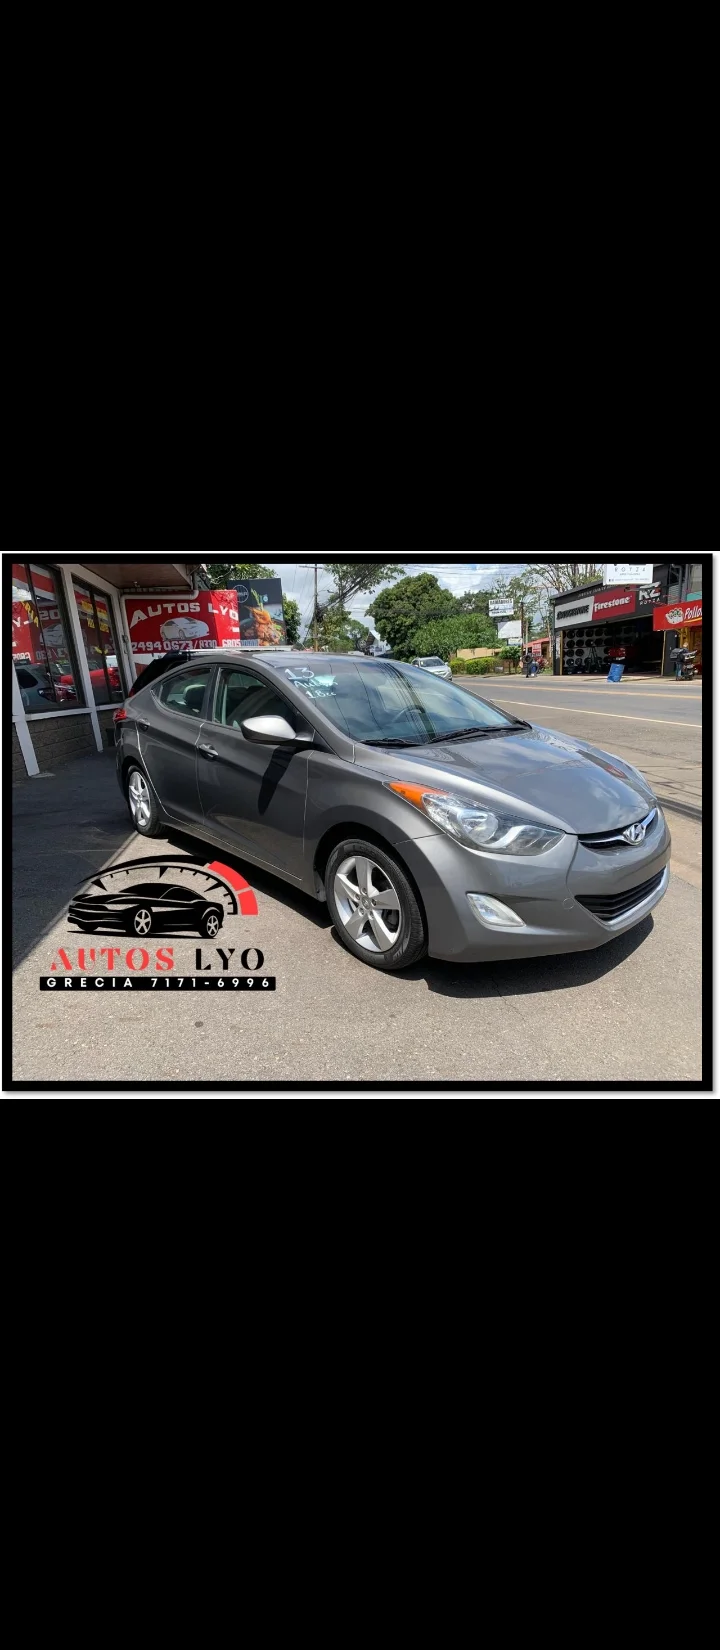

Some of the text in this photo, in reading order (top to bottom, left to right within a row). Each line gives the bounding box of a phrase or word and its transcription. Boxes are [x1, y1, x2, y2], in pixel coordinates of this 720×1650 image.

[594, 596, 631, 612] Firestone
[130, 602, 200, 628] AUTOS
[208, 603, 239, 621] LYO
[131, 641, 162, 651] 2494
[285, 667, 315, 680] 13
